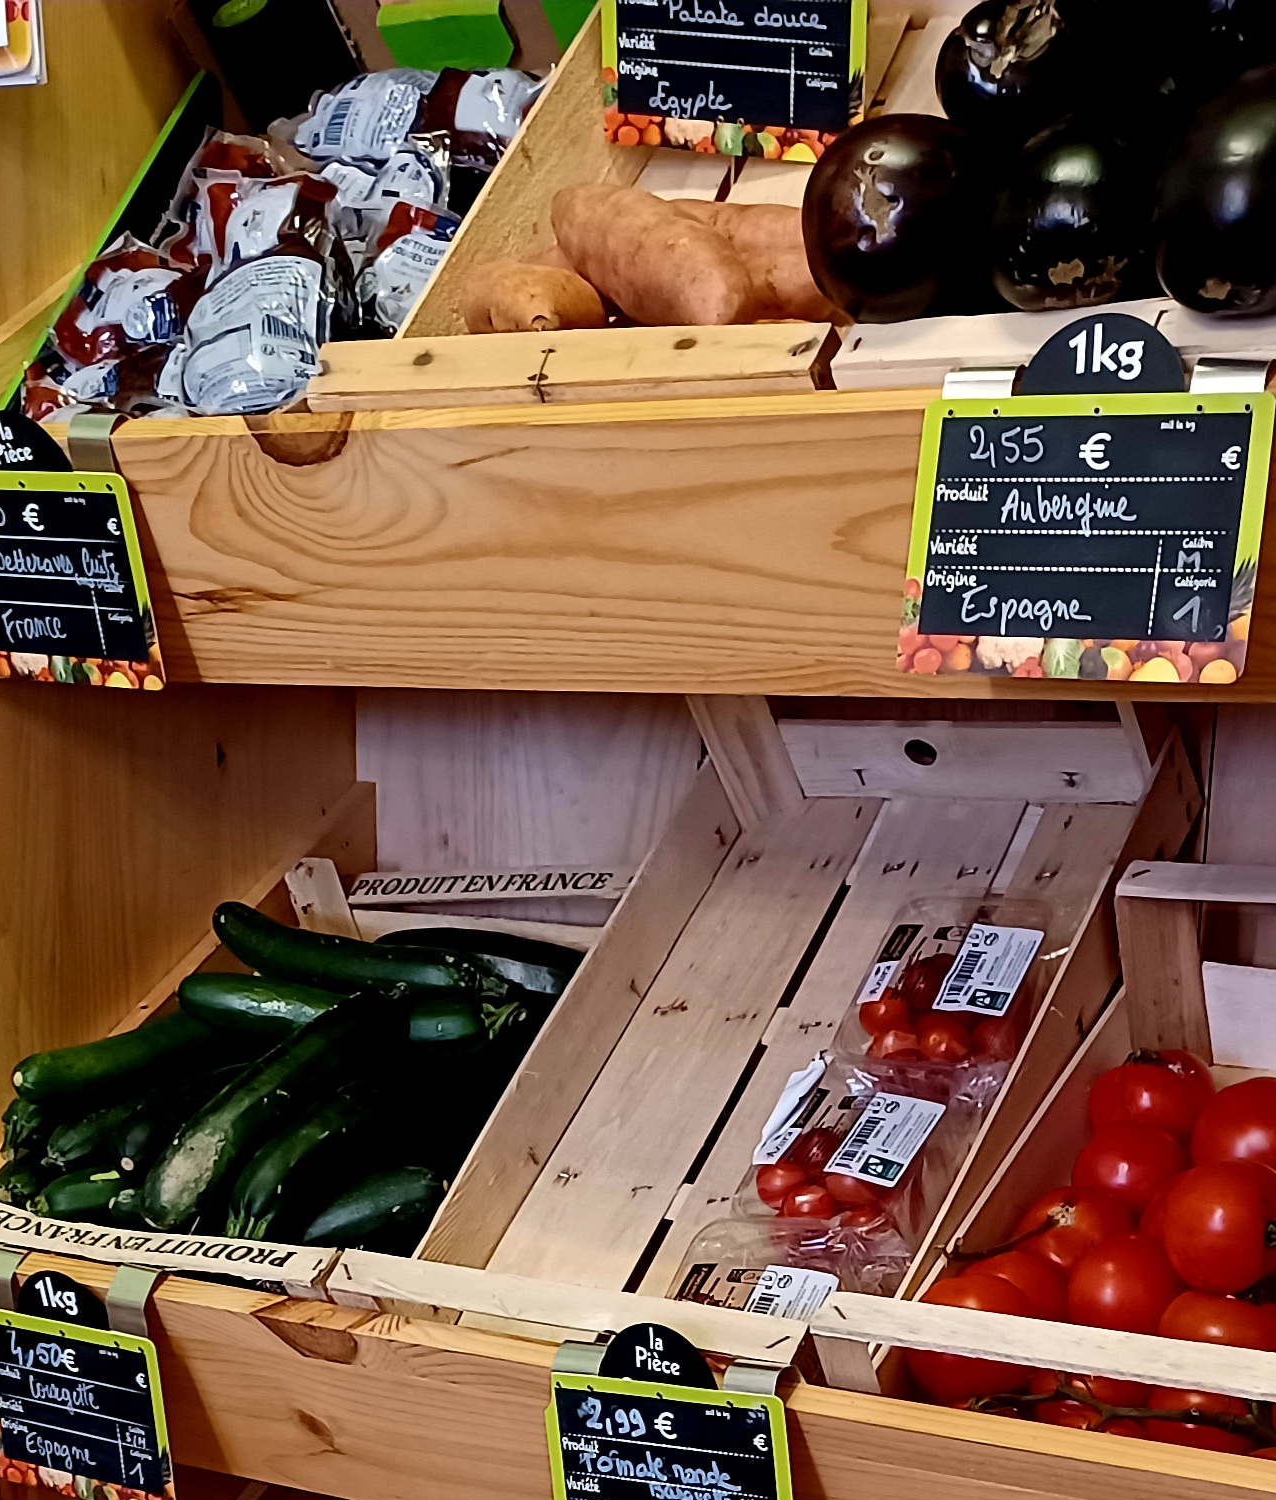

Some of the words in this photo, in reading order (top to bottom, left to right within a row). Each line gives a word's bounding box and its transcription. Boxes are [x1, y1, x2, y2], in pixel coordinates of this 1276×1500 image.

[668, 0, 744, 26] Patate
[753, 6, 827, 30] douce
[649, 80, 733, 118] Egypte
[1068, 323, 1145, 381] 1kg
[968, 424, 1045, 469] 2,55
[1079, 432, 1112, 469] €
[936, 484, 989, 502] Produit
[22, 503, 44, 531] €
[1000, 484, 1137, 536] Aubergine
[930, 537, 979, 556] Variété
[927, 570, 978, 588] Origine
[961, 585, 1092, 635] Espagne
[1173, 596, 1201, 632] 1
[1, 608, 67, 643] France
[350, 874, 466, 897] PRODUIT
[462, 874, 506, 893] EN
[504, 873, 614, 892] FRANCE
[102, 1234, 152, 1252] EN
[145, 1237, 298, 1270] PRODUIT
[34, 1277, 79, 1316] 1kg
[649, 1327, 664, 1351] la
[635, 1346, 680, 1376] Pièce
[654, 1412, 677, 1439] €
[26, 1432, 97, 1470] Espagne
[562, 1437, 599, 1453] Produit
[566, 1478, 600, 1493] Variété
